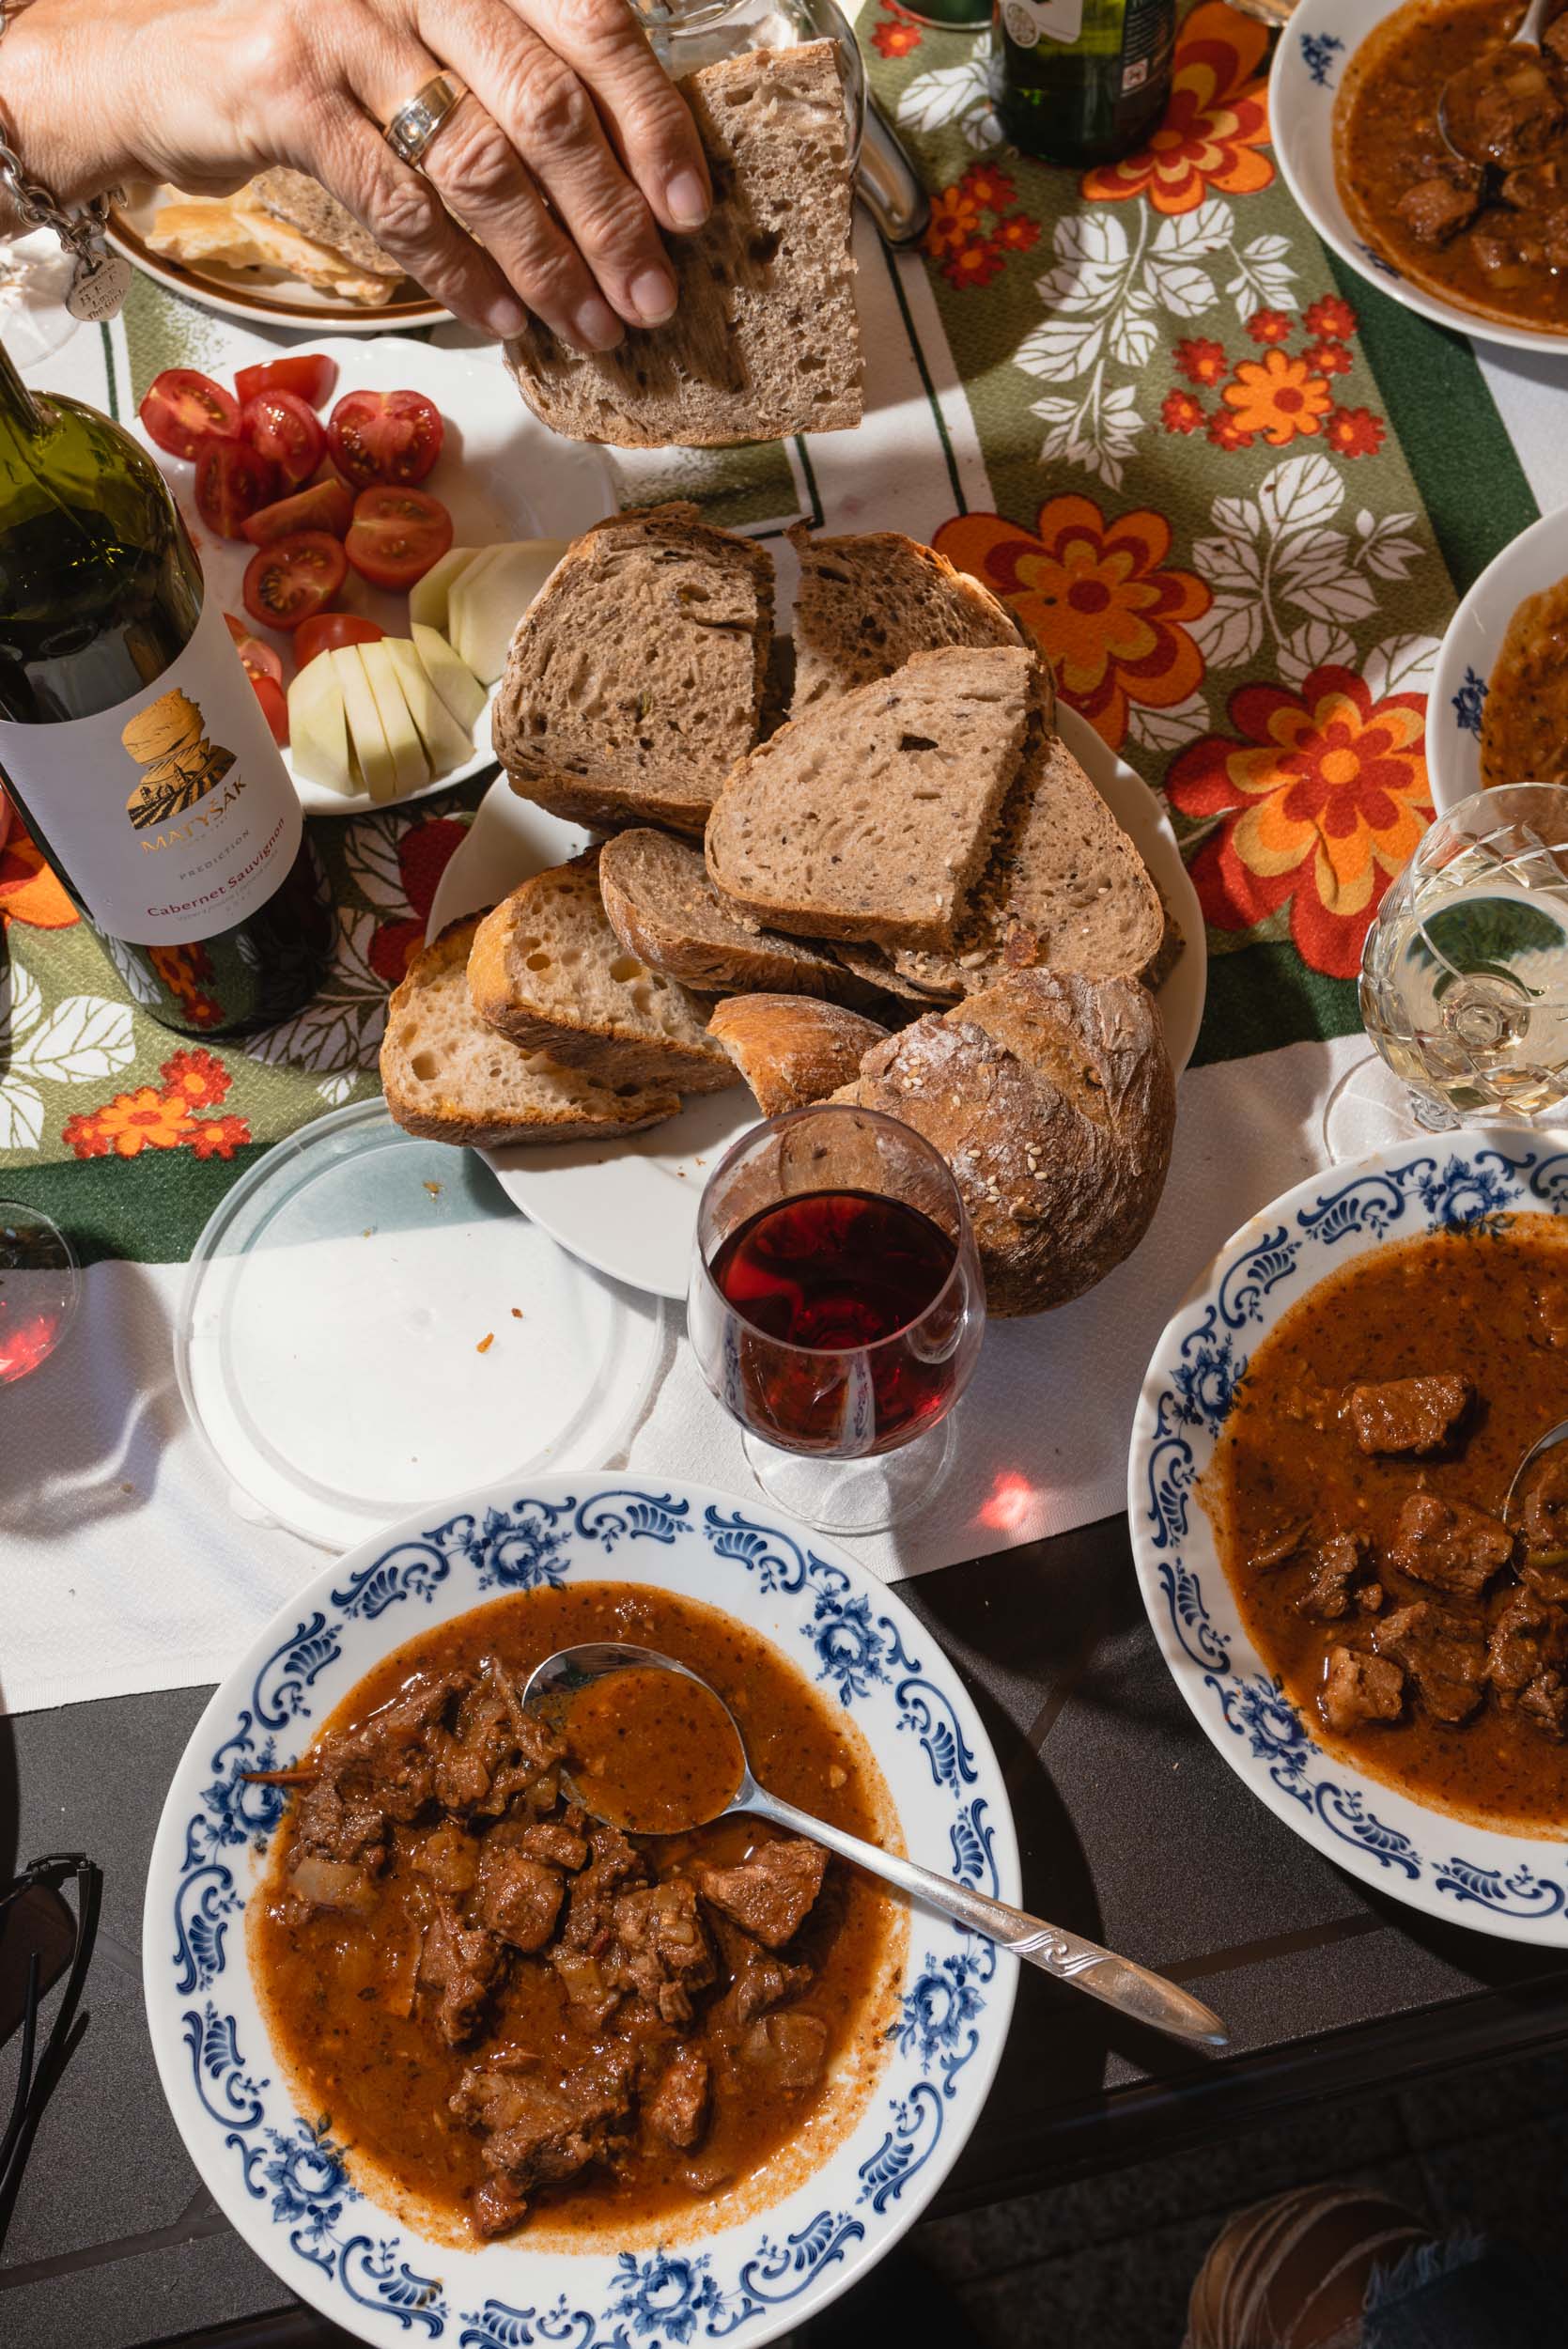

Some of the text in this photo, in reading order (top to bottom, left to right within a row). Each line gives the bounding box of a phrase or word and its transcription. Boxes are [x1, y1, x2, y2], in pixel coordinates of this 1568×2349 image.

[141, 774, 247, 856] MATYŠÁK
[179, 829, 250, 879] PREDICTION
[147, 886, 226, 916] Cabernet
[227, 817, 285, 888] Sauvignon
